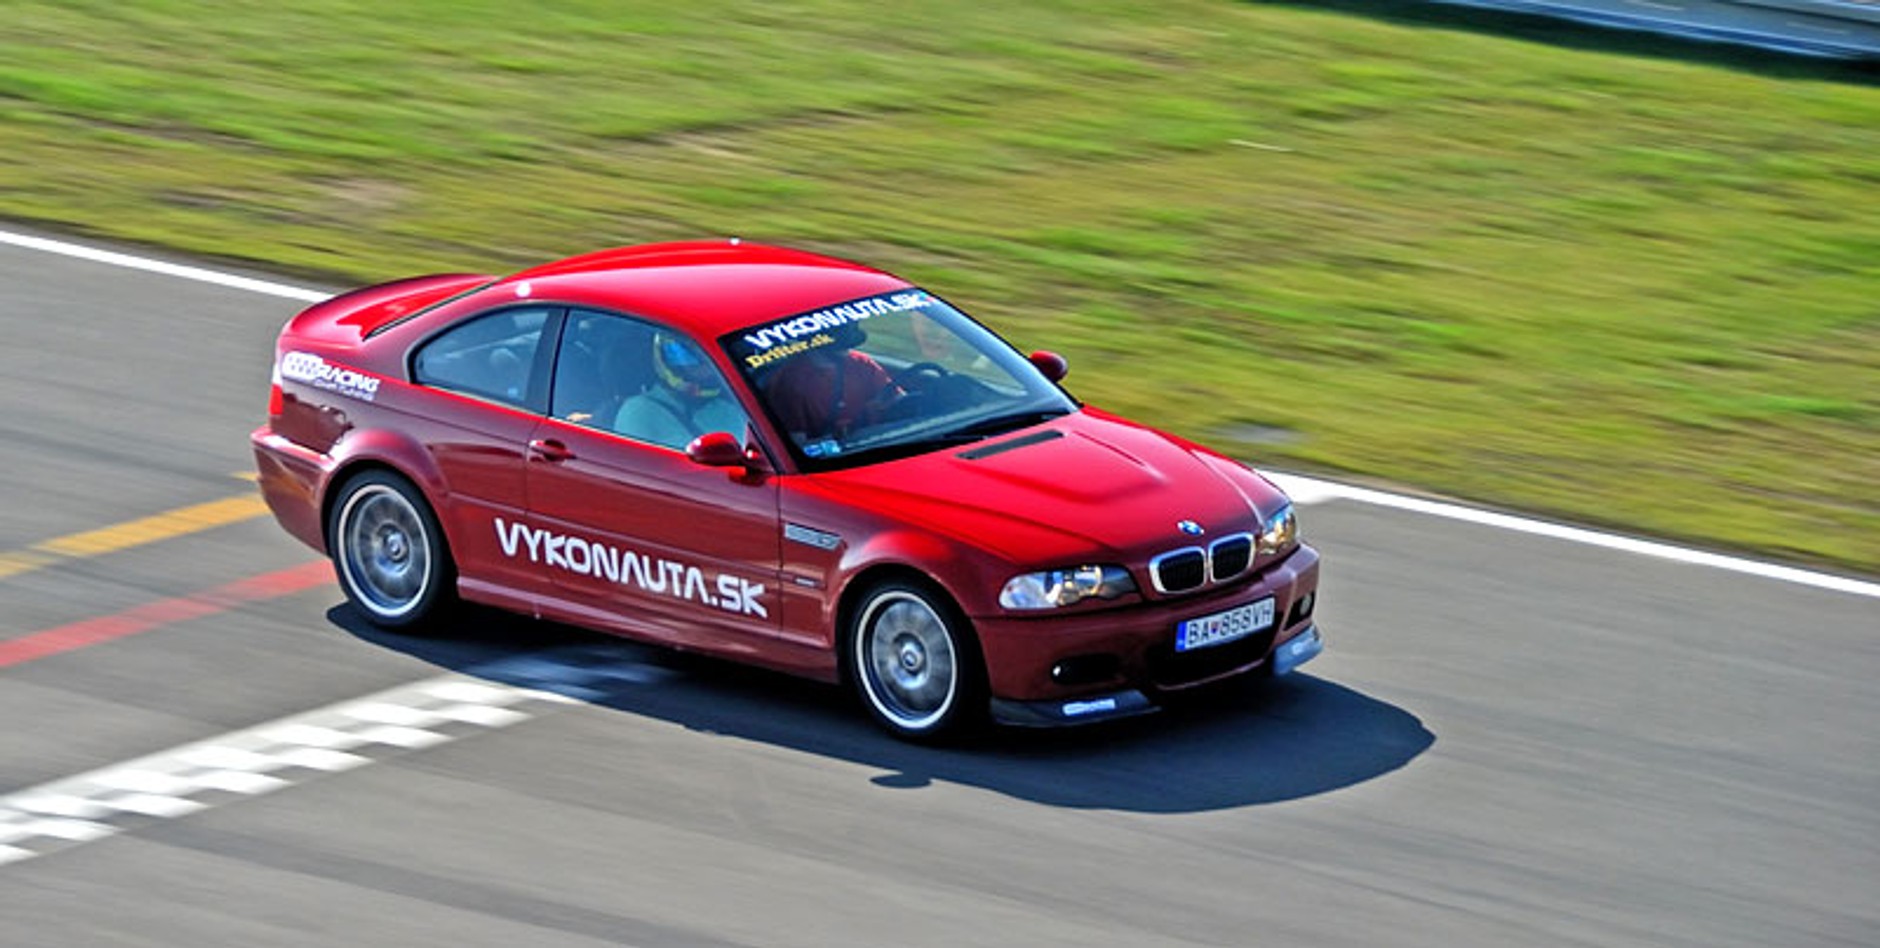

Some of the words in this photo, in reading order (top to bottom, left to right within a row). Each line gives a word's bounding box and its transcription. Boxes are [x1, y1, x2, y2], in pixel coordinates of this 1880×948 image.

[744, 293, 931, 349] VYKONAUTA.SK
[745, 334, 834, 369] Drifter.sk
[317, 363, 380, 393] RACING
[495, 518, 767, 618] VYKONAUTA.SK
